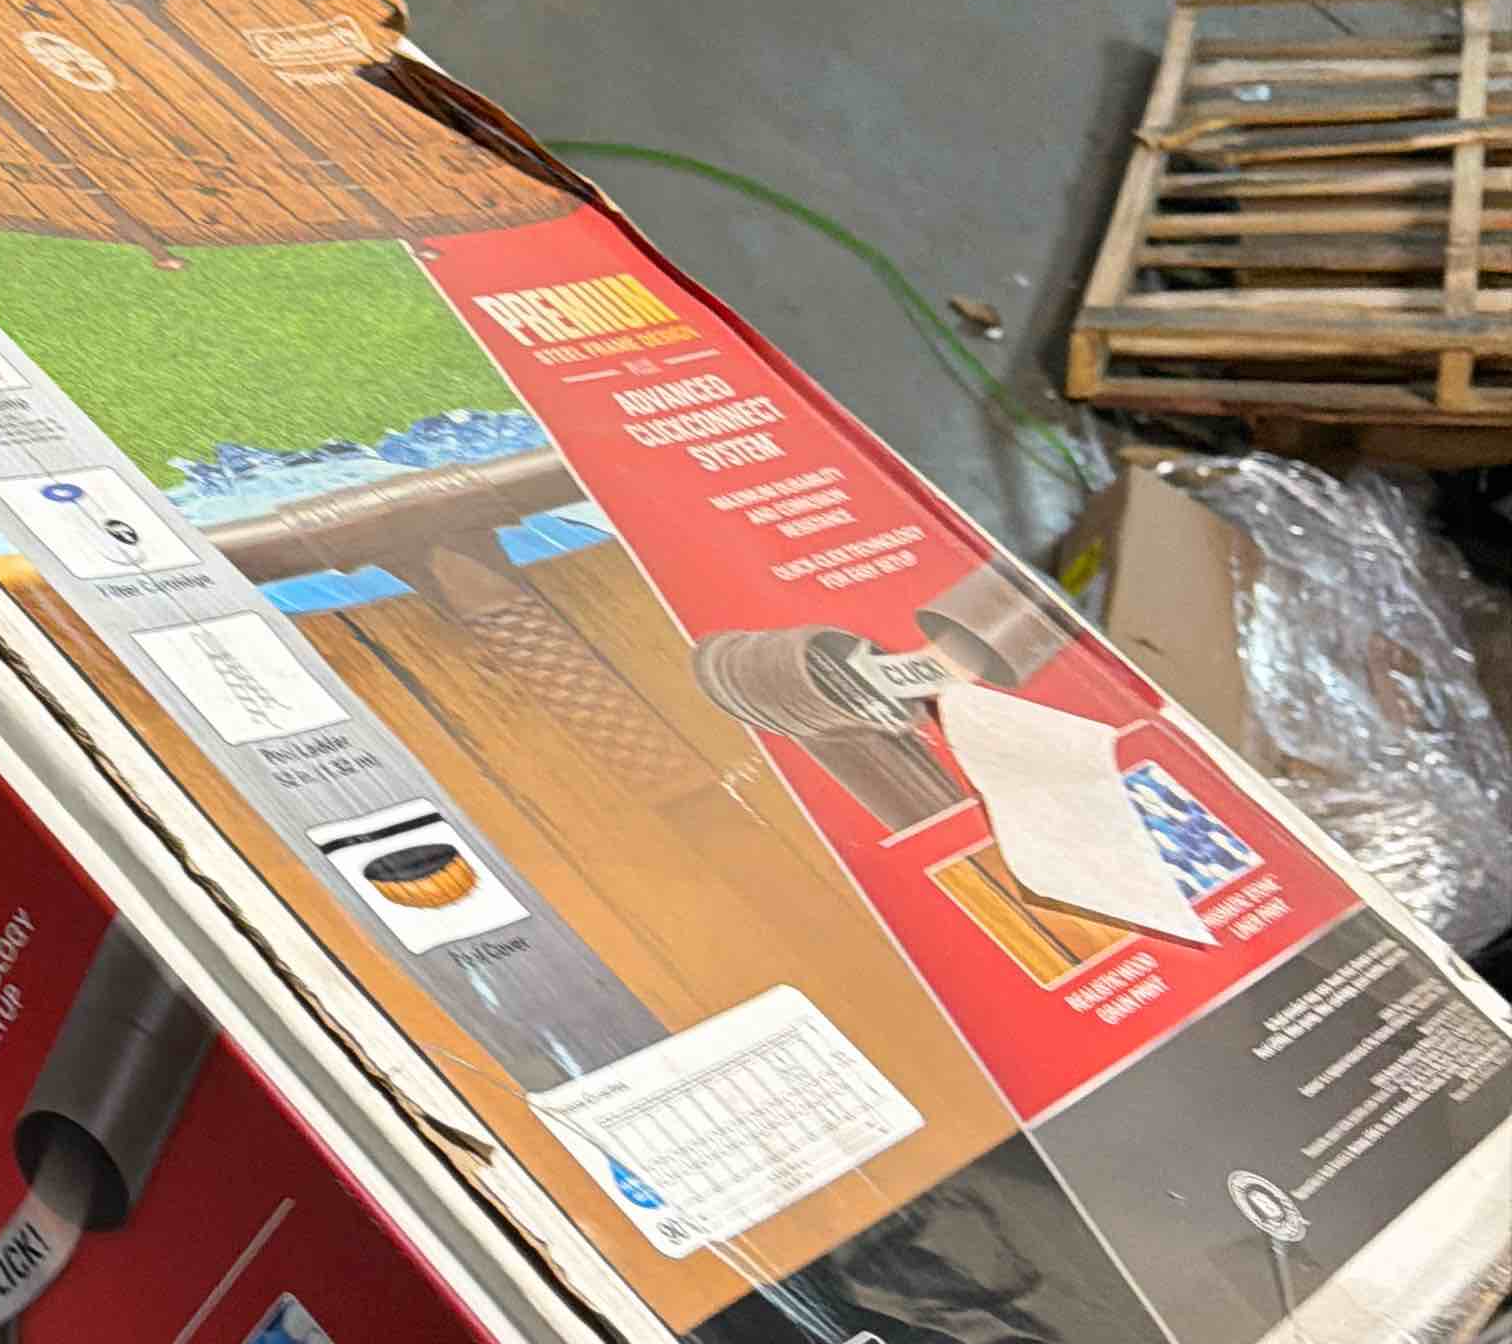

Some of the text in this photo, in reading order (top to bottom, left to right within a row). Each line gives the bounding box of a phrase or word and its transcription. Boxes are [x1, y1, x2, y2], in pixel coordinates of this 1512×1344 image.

[470, 272, 681, 347] PREMIUM
[608, 372, 738, 418] ADVANCED
[622, 396, 789, 450] CLICKCONNECT
[290, 733, 354, 759] Ladder
[478, 931, 534, 963] Cover
